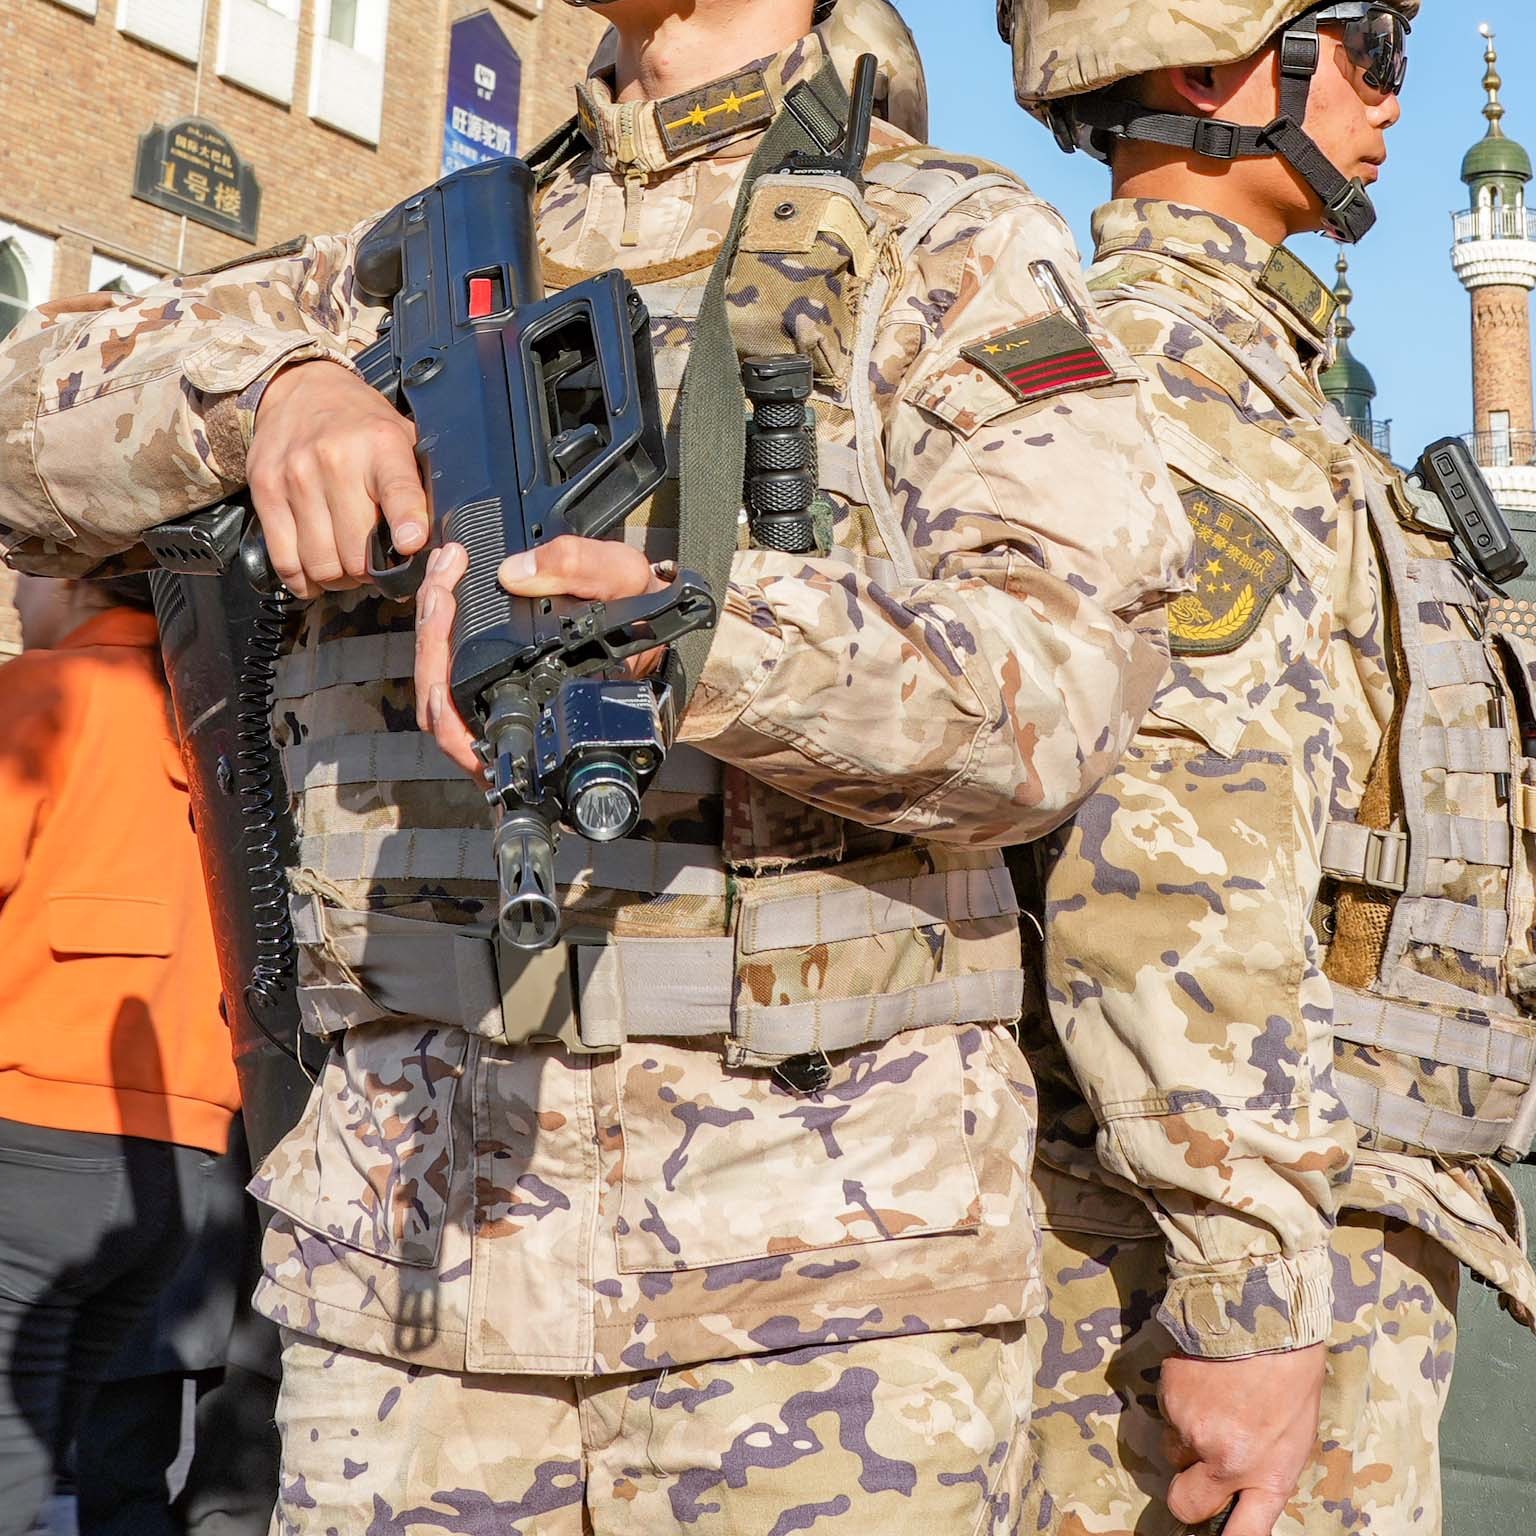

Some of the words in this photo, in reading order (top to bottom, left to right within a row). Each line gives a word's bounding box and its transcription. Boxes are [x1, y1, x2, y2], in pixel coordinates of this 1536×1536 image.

[452, 105, 512, 155] 旺源驼奶
[158, 160, 241, 216] 1号楼
[1192, 501, 1276, 568] 中国人民
